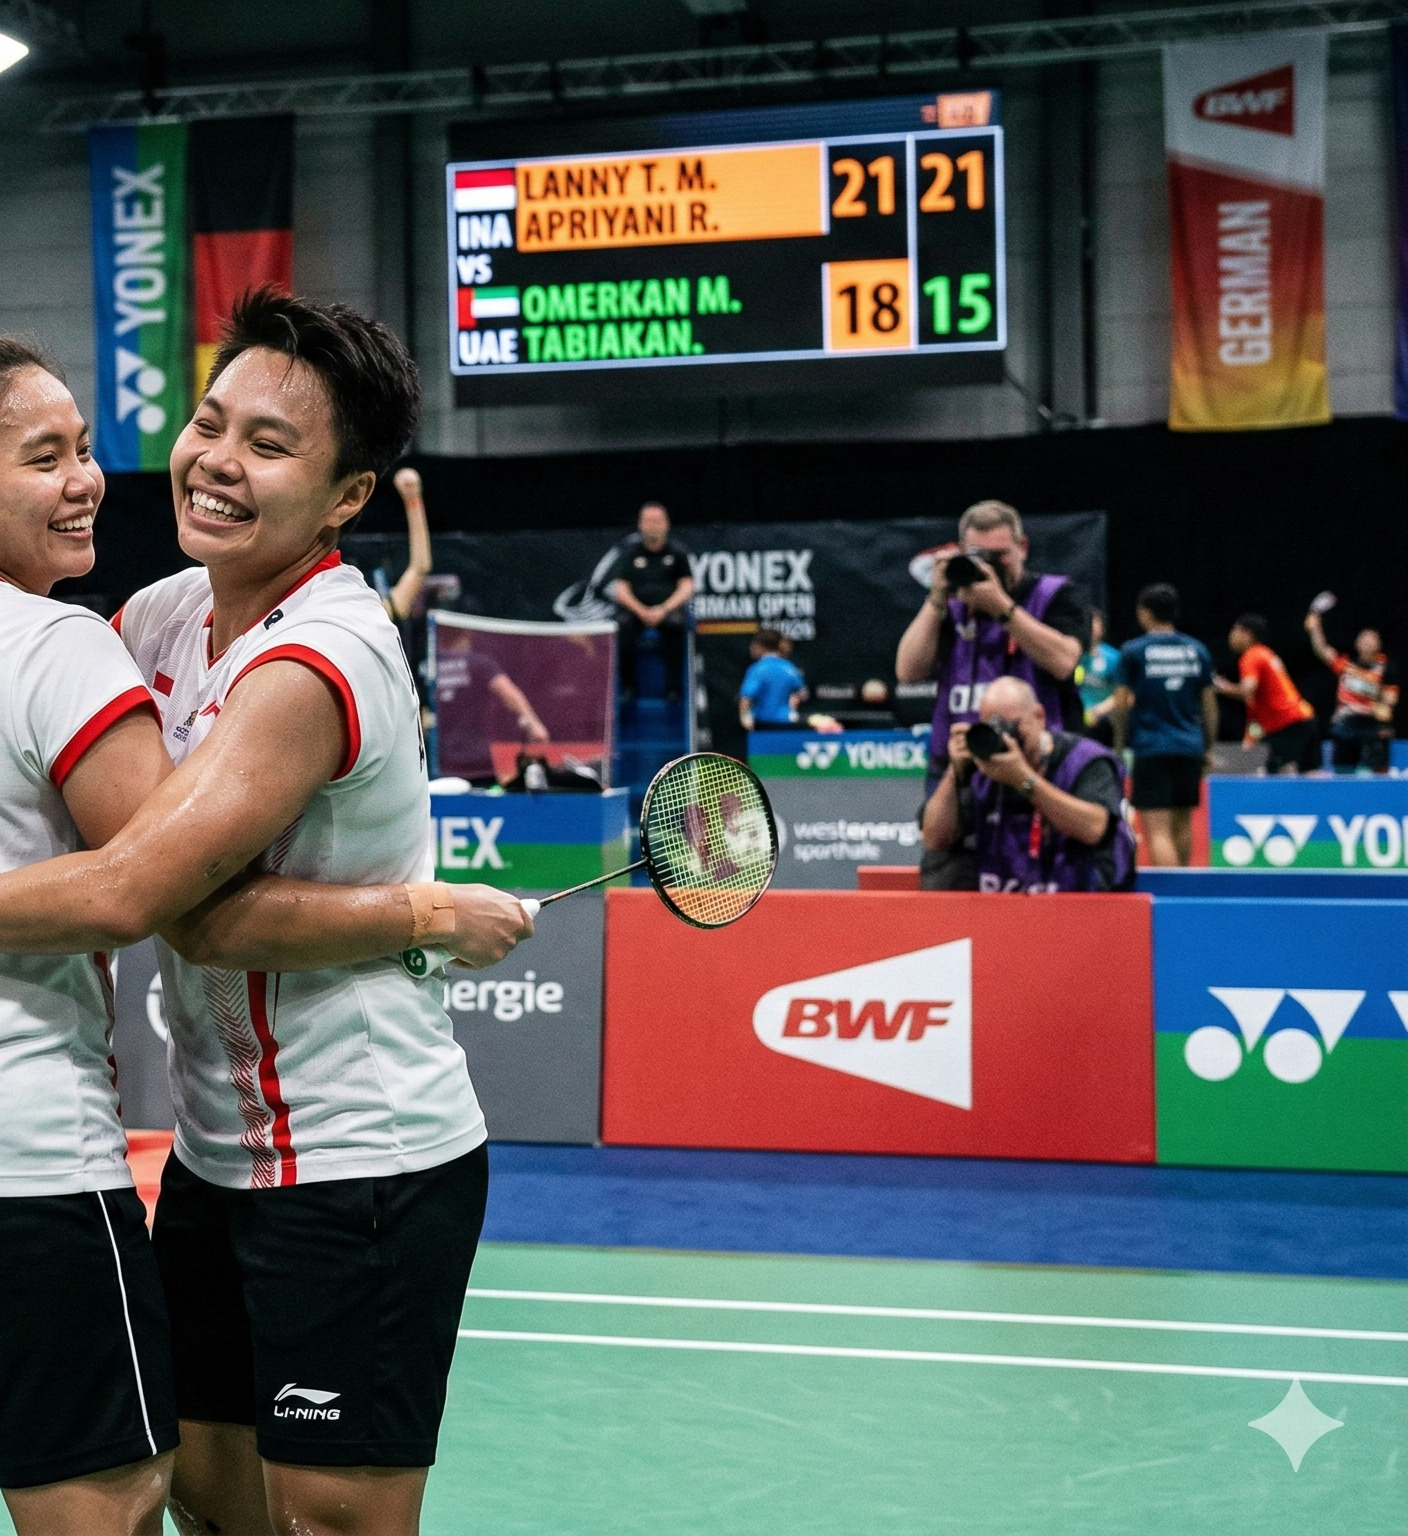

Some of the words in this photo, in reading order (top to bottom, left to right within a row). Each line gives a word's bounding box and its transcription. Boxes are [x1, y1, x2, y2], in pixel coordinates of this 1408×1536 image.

[523, 164, 631, 201] LANNY
[642, 162, 666, 194] T.
[677, 158, 718, 191] M.
[831, 155, 896, 218] 21
[919, 149, 986, 213] 21
[457, 212, 514, 250] INA
[523, 204, 677, 243] APRIYANI
[689, 201, 720, 233] R.
[112, 163, 167, 337] YONEX
[456, 253, 493, 285] VS
[521, 276, 691, 324] OMERKAN
[696, 274, 742, 316] M.
[922, 272, 992, 335] 15
[1217, 200, 1272, 366] GERMAN
[838, 281, 901, 335] 18
[458, 327, 520, 366] UAE
[521, 318, 705, 364] TABIAKAN.
[687, 548, 813, 593] YONEX
[844, 741, 928, 770] YONEX
[1326, 813, 1408, 868] YO
[782, 997, 954, 1042] BWF
